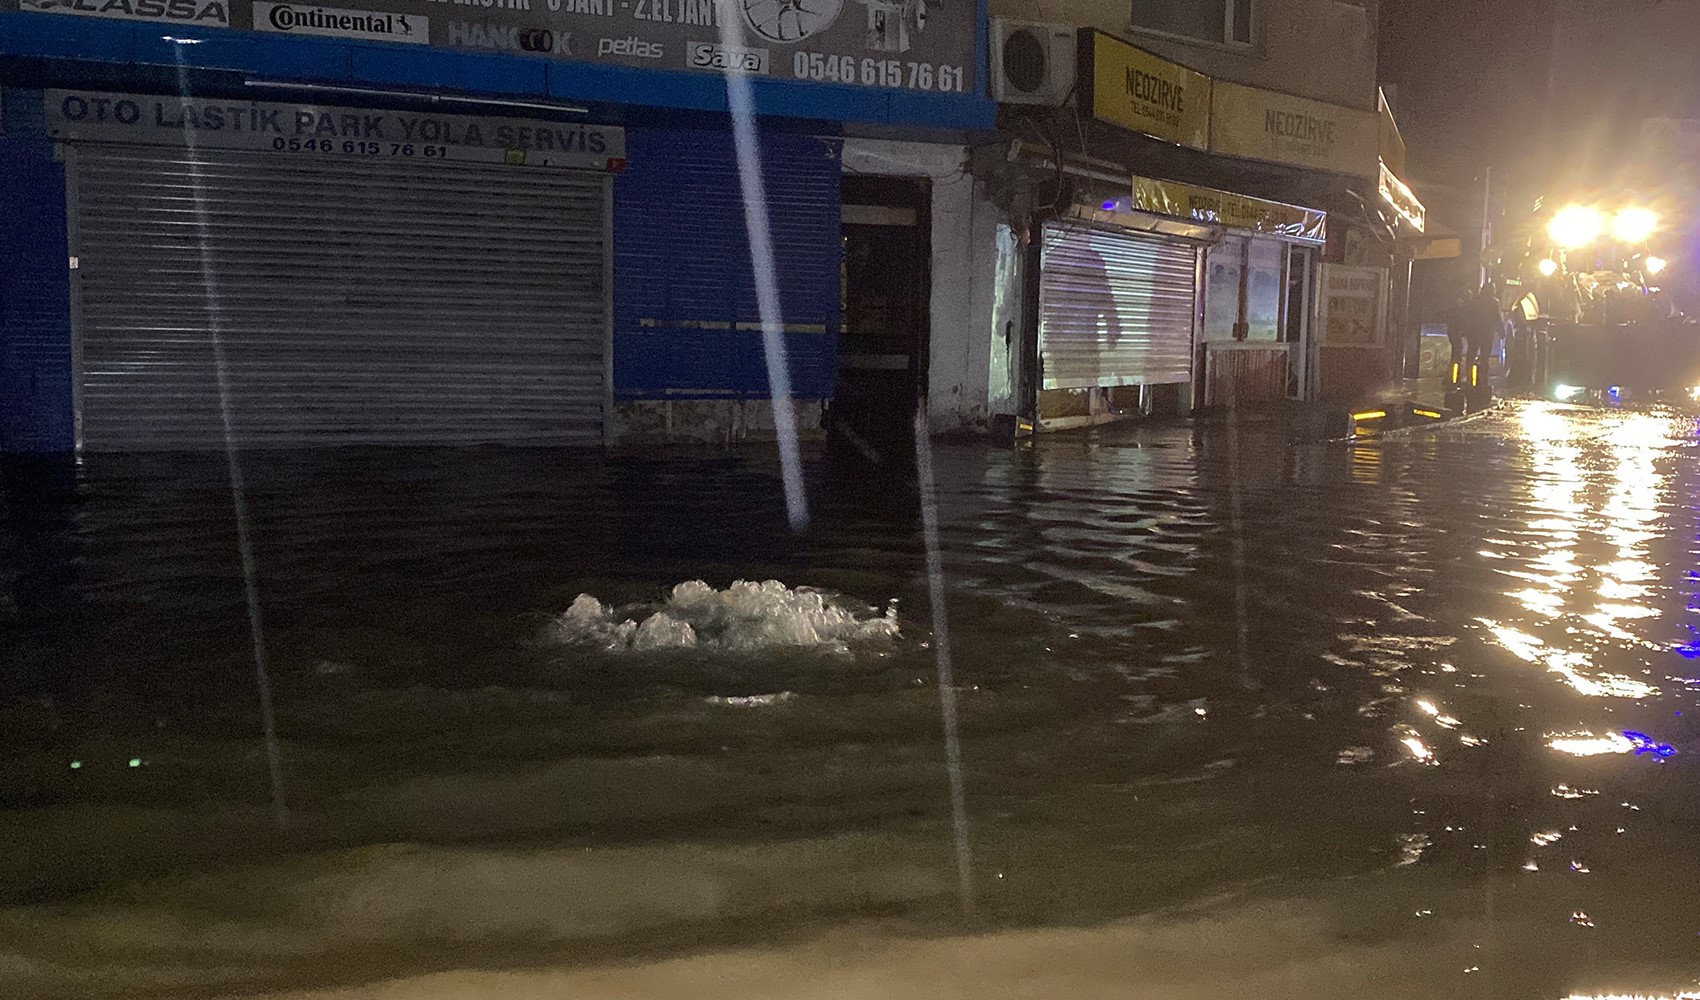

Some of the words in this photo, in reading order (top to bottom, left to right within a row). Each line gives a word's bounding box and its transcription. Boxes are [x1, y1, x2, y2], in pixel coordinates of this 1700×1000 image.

[269, 4, 393, 33] Continental
[597, 37, 664, 59] petlas
[693, 46, 761, 72] Sava
[793, 51, 855, 83] 0546
[859, 58, 901, 87] 615
[906, 64, 933, 91] 76
[938, 66, 964, 92] 61
[61, 96, 140, 124] OTO
[156, 101, 282, 133] LASTİK
[296, 110, 384, 139] PARK
[399, 116, 484, 146] YOLA
[496, 125, 607, 154] SERVİS
[272, 137, 333, 152] 0546
[342, 141, 381, 154] 615
[391, 144, 414, 156] 76
[423, 146, 447, 158] 61
